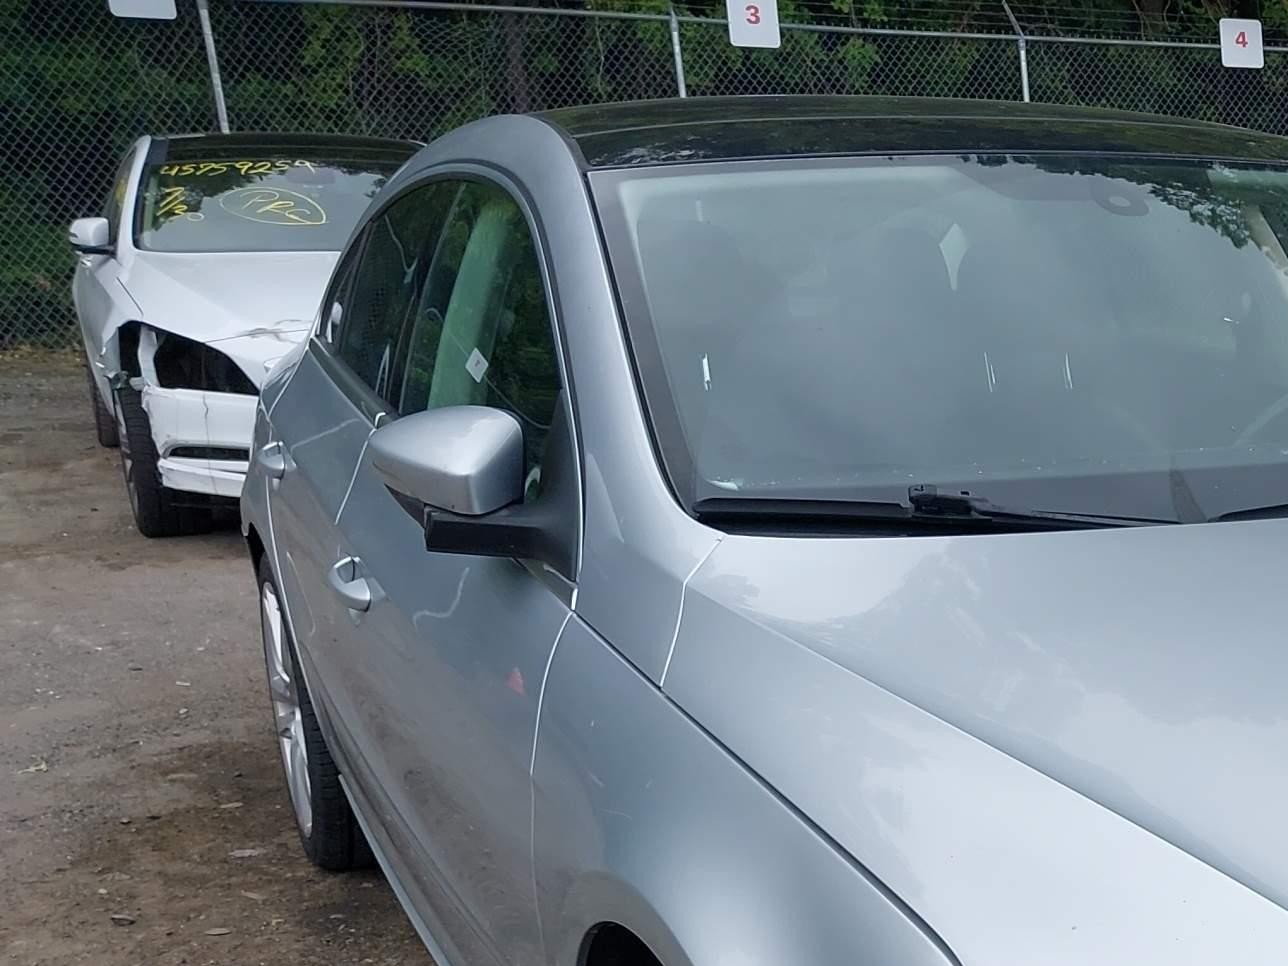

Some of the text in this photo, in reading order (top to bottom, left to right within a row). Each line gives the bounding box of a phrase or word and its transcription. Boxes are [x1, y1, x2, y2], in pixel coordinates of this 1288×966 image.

[745, 5, 761, 25] 3
[1235, 31, 1249, 48] 4
[159, 159, 316, 177] 45759259
